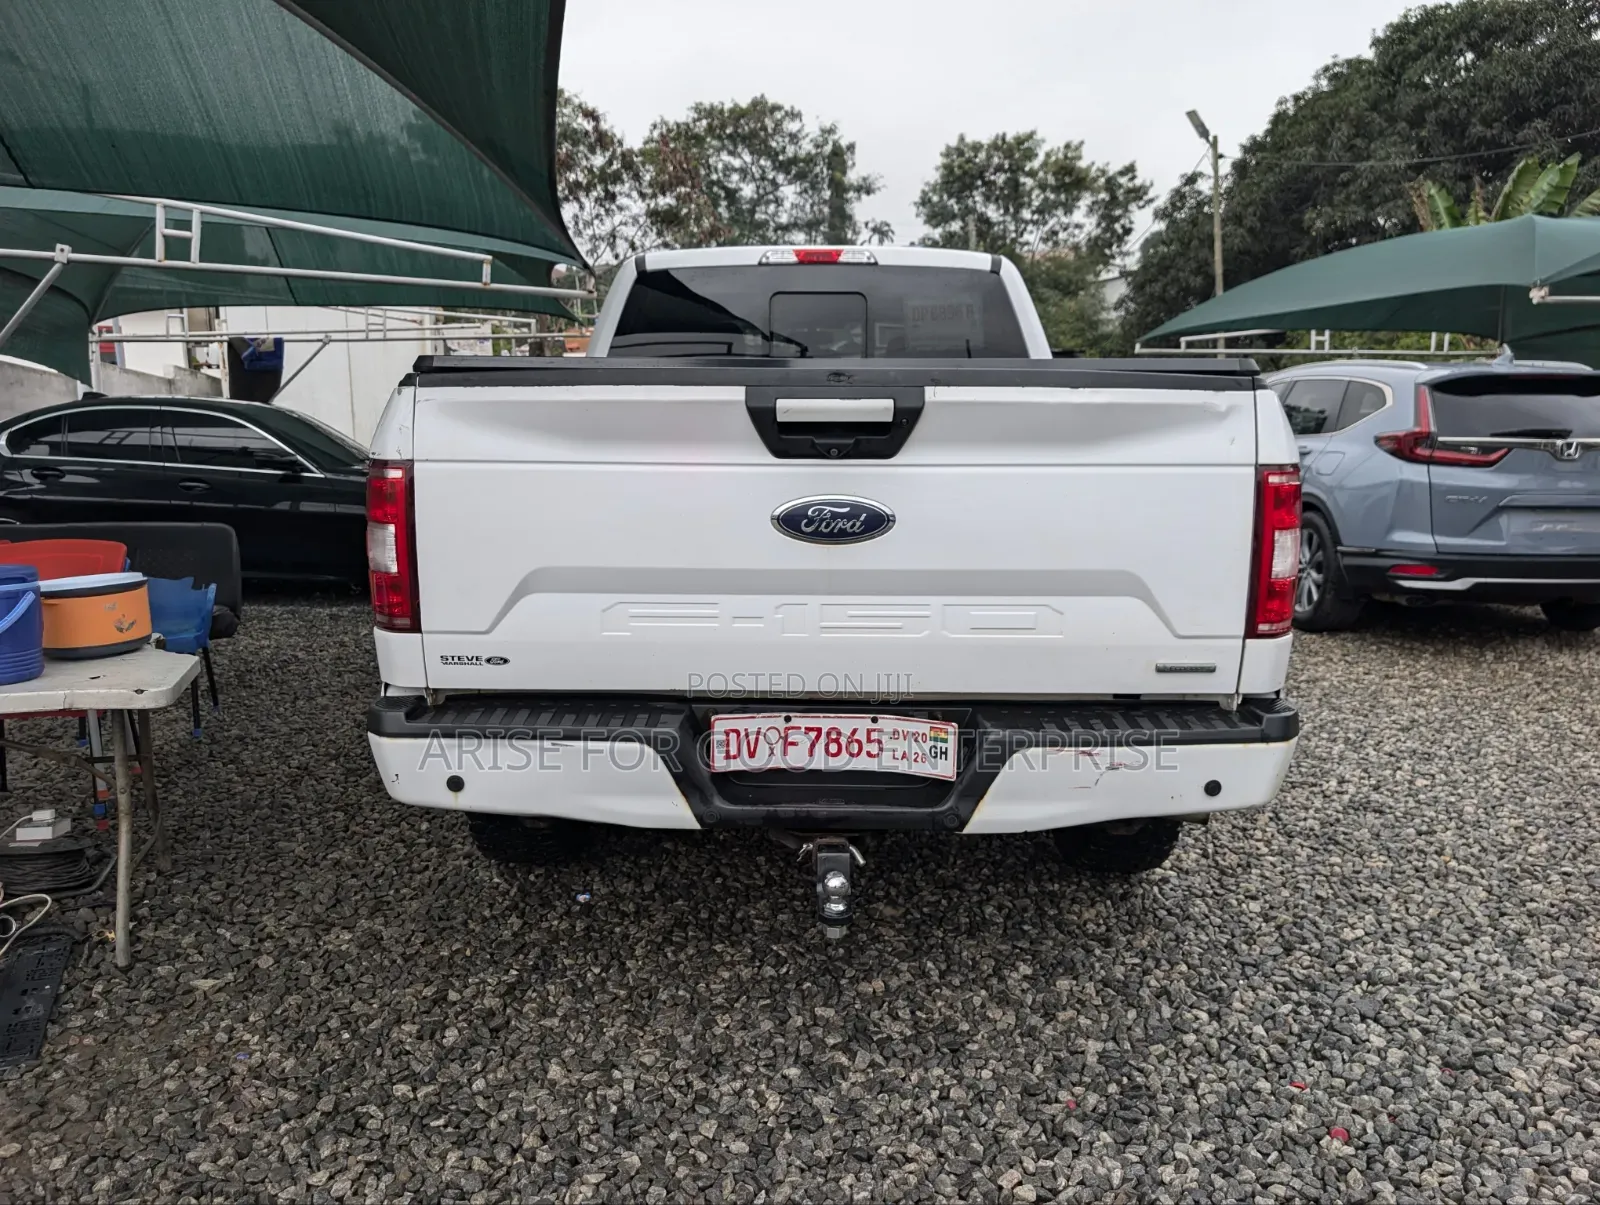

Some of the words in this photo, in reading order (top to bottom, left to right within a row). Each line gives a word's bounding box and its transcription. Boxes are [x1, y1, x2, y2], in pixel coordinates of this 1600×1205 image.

[801, 505, 867, 533] Ford
[601, 602, 1064, 638] F-150
[723, 727, 762, 760] DV
[782, 726, 884, 759] F7865
[928, 744, 949, 762] GH
